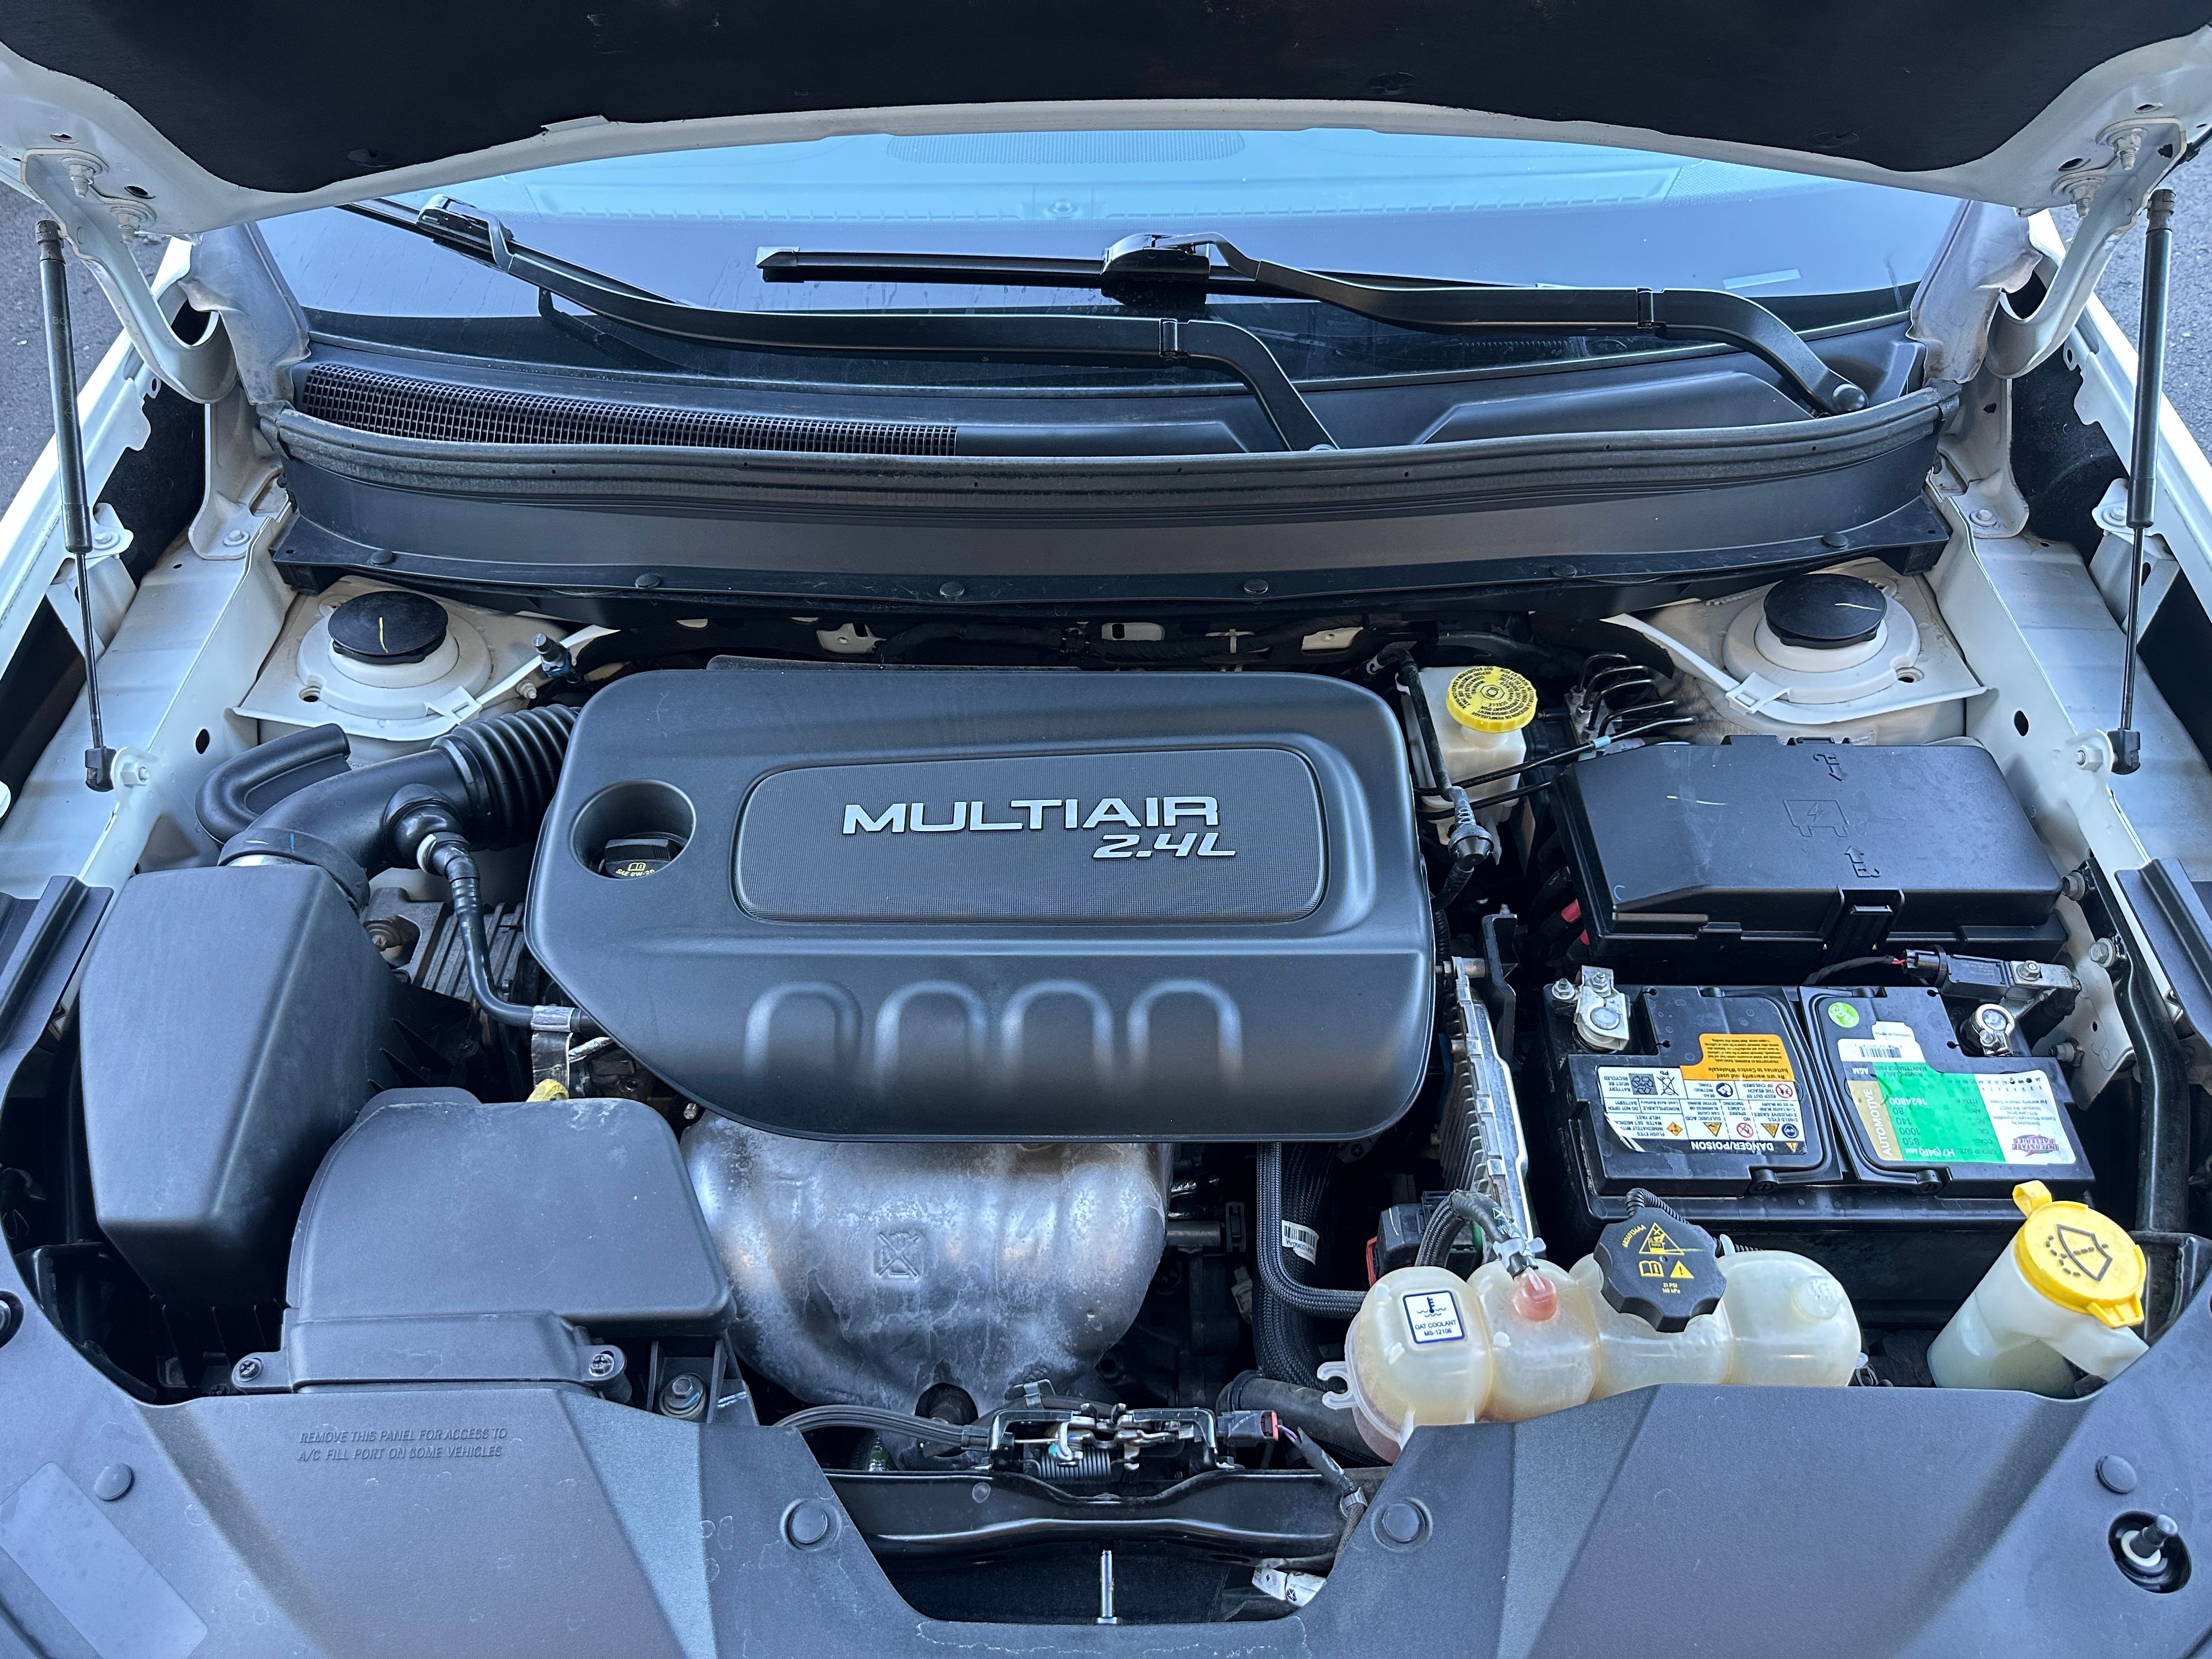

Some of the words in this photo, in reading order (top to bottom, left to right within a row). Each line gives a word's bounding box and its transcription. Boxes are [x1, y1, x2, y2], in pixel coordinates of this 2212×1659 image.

[842, 795, 1220, 834] MULTIAIR
[1093, 832, 1237, 859] 2.4L
[1863, 1088, 1892, 1156] AUTOMOTIVE
[1691, 1141, 1774, 1151] DANGER/POISON
[1919, 1147, 1942, 1156] (94R)
[1943, 1148, 1955, 1156] H7
[1428, 1320, 1456, 1328] COOLANT
[300, 1431, 348, 1443] REMOVE
[351, 1430, 376, 1442] THIS
[379, 1429, 415, 1442] PANEL
[418, 1429, 442, 1441] FOR
[444, 1428, 489, 1441] ACCESS
[493, 1427, 507, 1440] TO
[297, 1448, 321, 1462] A/C
[325, 1448, 348, 1460] FILL
[353, 1448, 385, 1460] PORT
[388, 1447, 406, 1459] ON
[409, 1446, 443, 1459] SOME
[447, 1445, 502, 1458] VEHICLES
